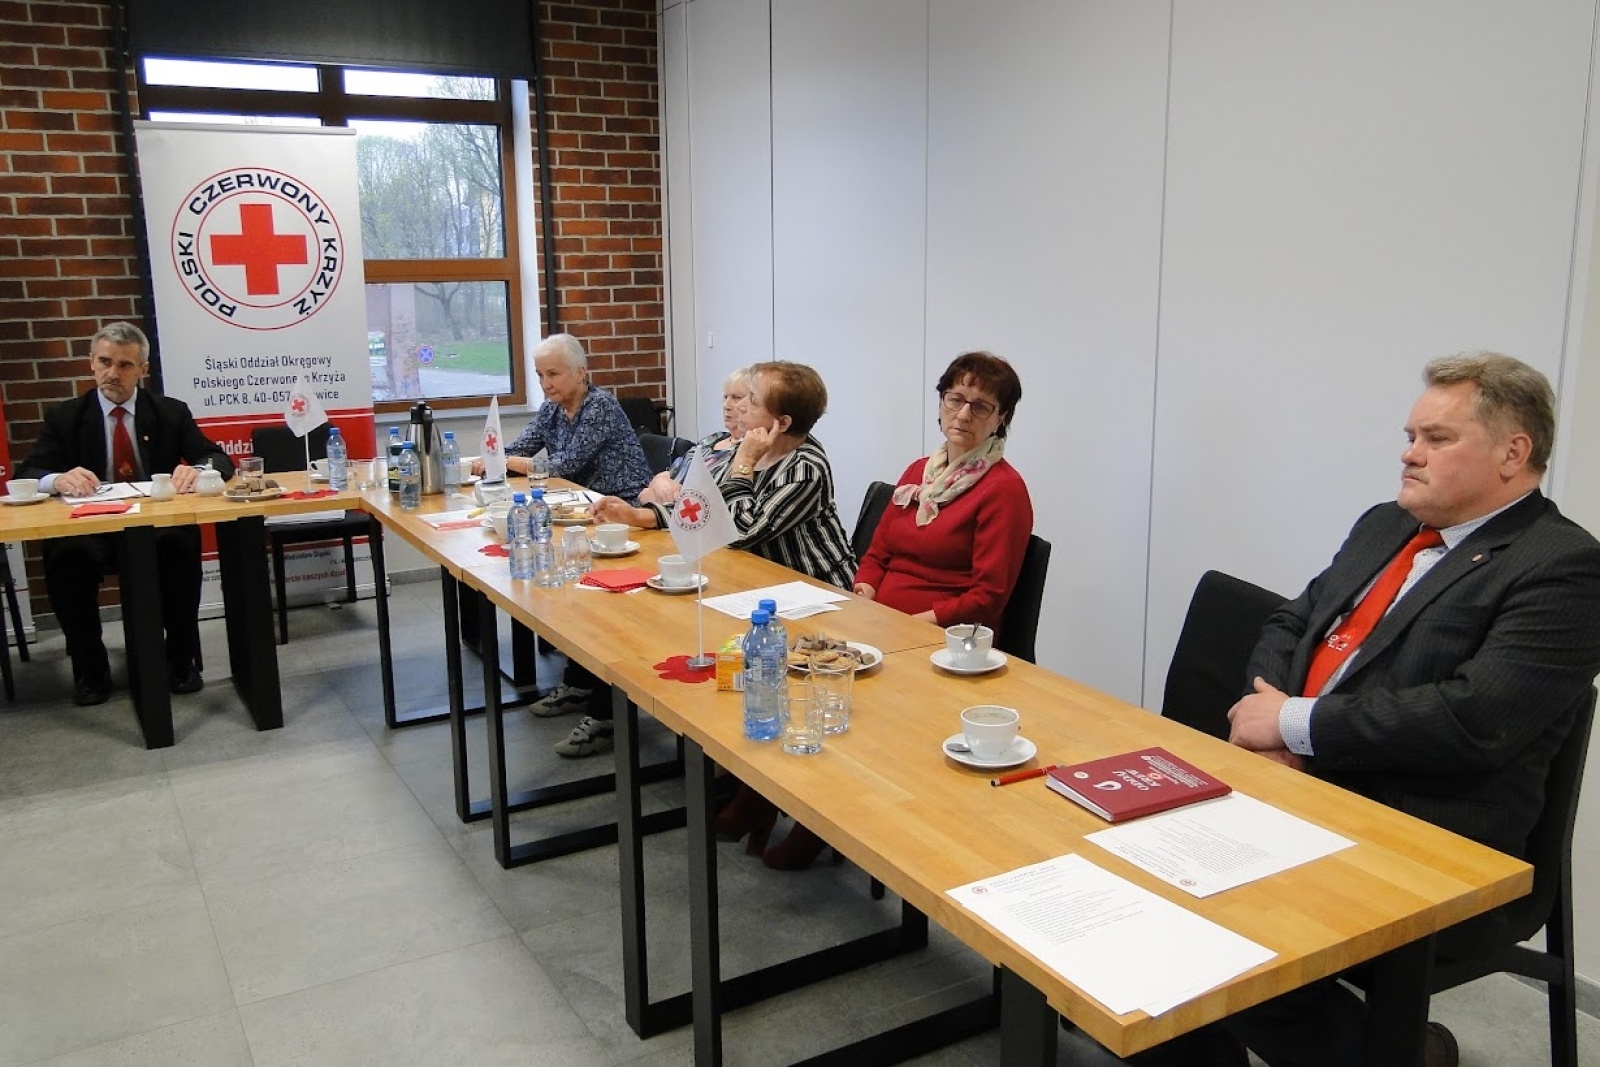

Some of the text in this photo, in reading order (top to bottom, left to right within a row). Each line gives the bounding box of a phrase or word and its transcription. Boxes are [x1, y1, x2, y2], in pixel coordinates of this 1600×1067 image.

[177, 173, 338, 318] POLSKI CZERWONY KRZYŻ
[204, 355, 332, 373] Śląski Oddział Okręgowy
[193, 370, 346, 390] Polskiego Czerwoneo Krzyża
[203, 395, 217, 407] ul.
[219, 392, 240, 406] PCK
[253, 390, 291, 403] 40-057
[314, 388, 340, 400] wice
